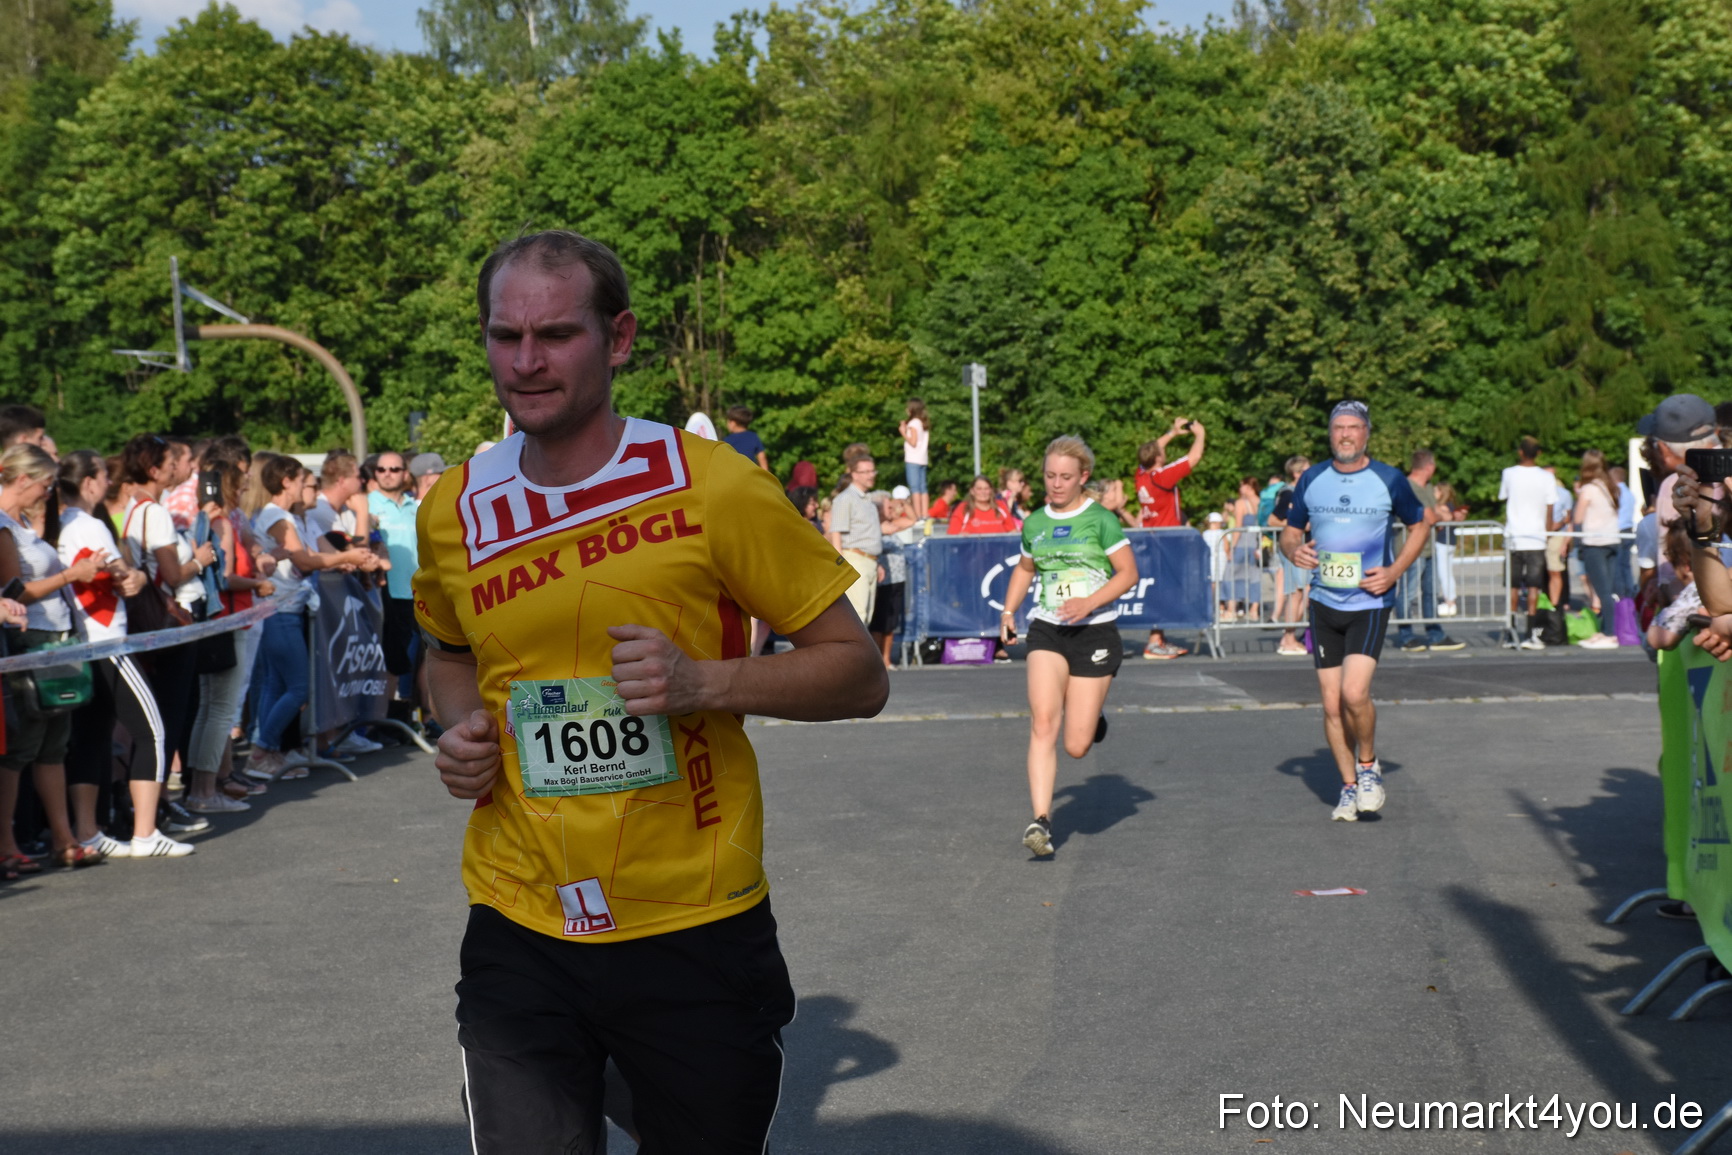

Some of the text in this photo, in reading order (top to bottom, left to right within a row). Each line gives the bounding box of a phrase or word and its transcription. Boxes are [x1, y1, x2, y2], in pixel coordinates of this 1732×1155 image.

[471, 549, 565, 615] MAX
[576, 508, 702, 569] BÖGL
[1322, 563, 1354, 578] 2123
[1056, 584, 1071, 597] 41
[534, 701, 588, 714] firmenlauf
[534, 716, 649, 763] 1608
[563, 761, 626, 775] Kerl Bernd
[544, 778, 559, 786] Max
[560, 776, 578, 787] Bögl
[580, 773, 623, 784] Bauservice
[625, 768, 651, 778] GmbH
